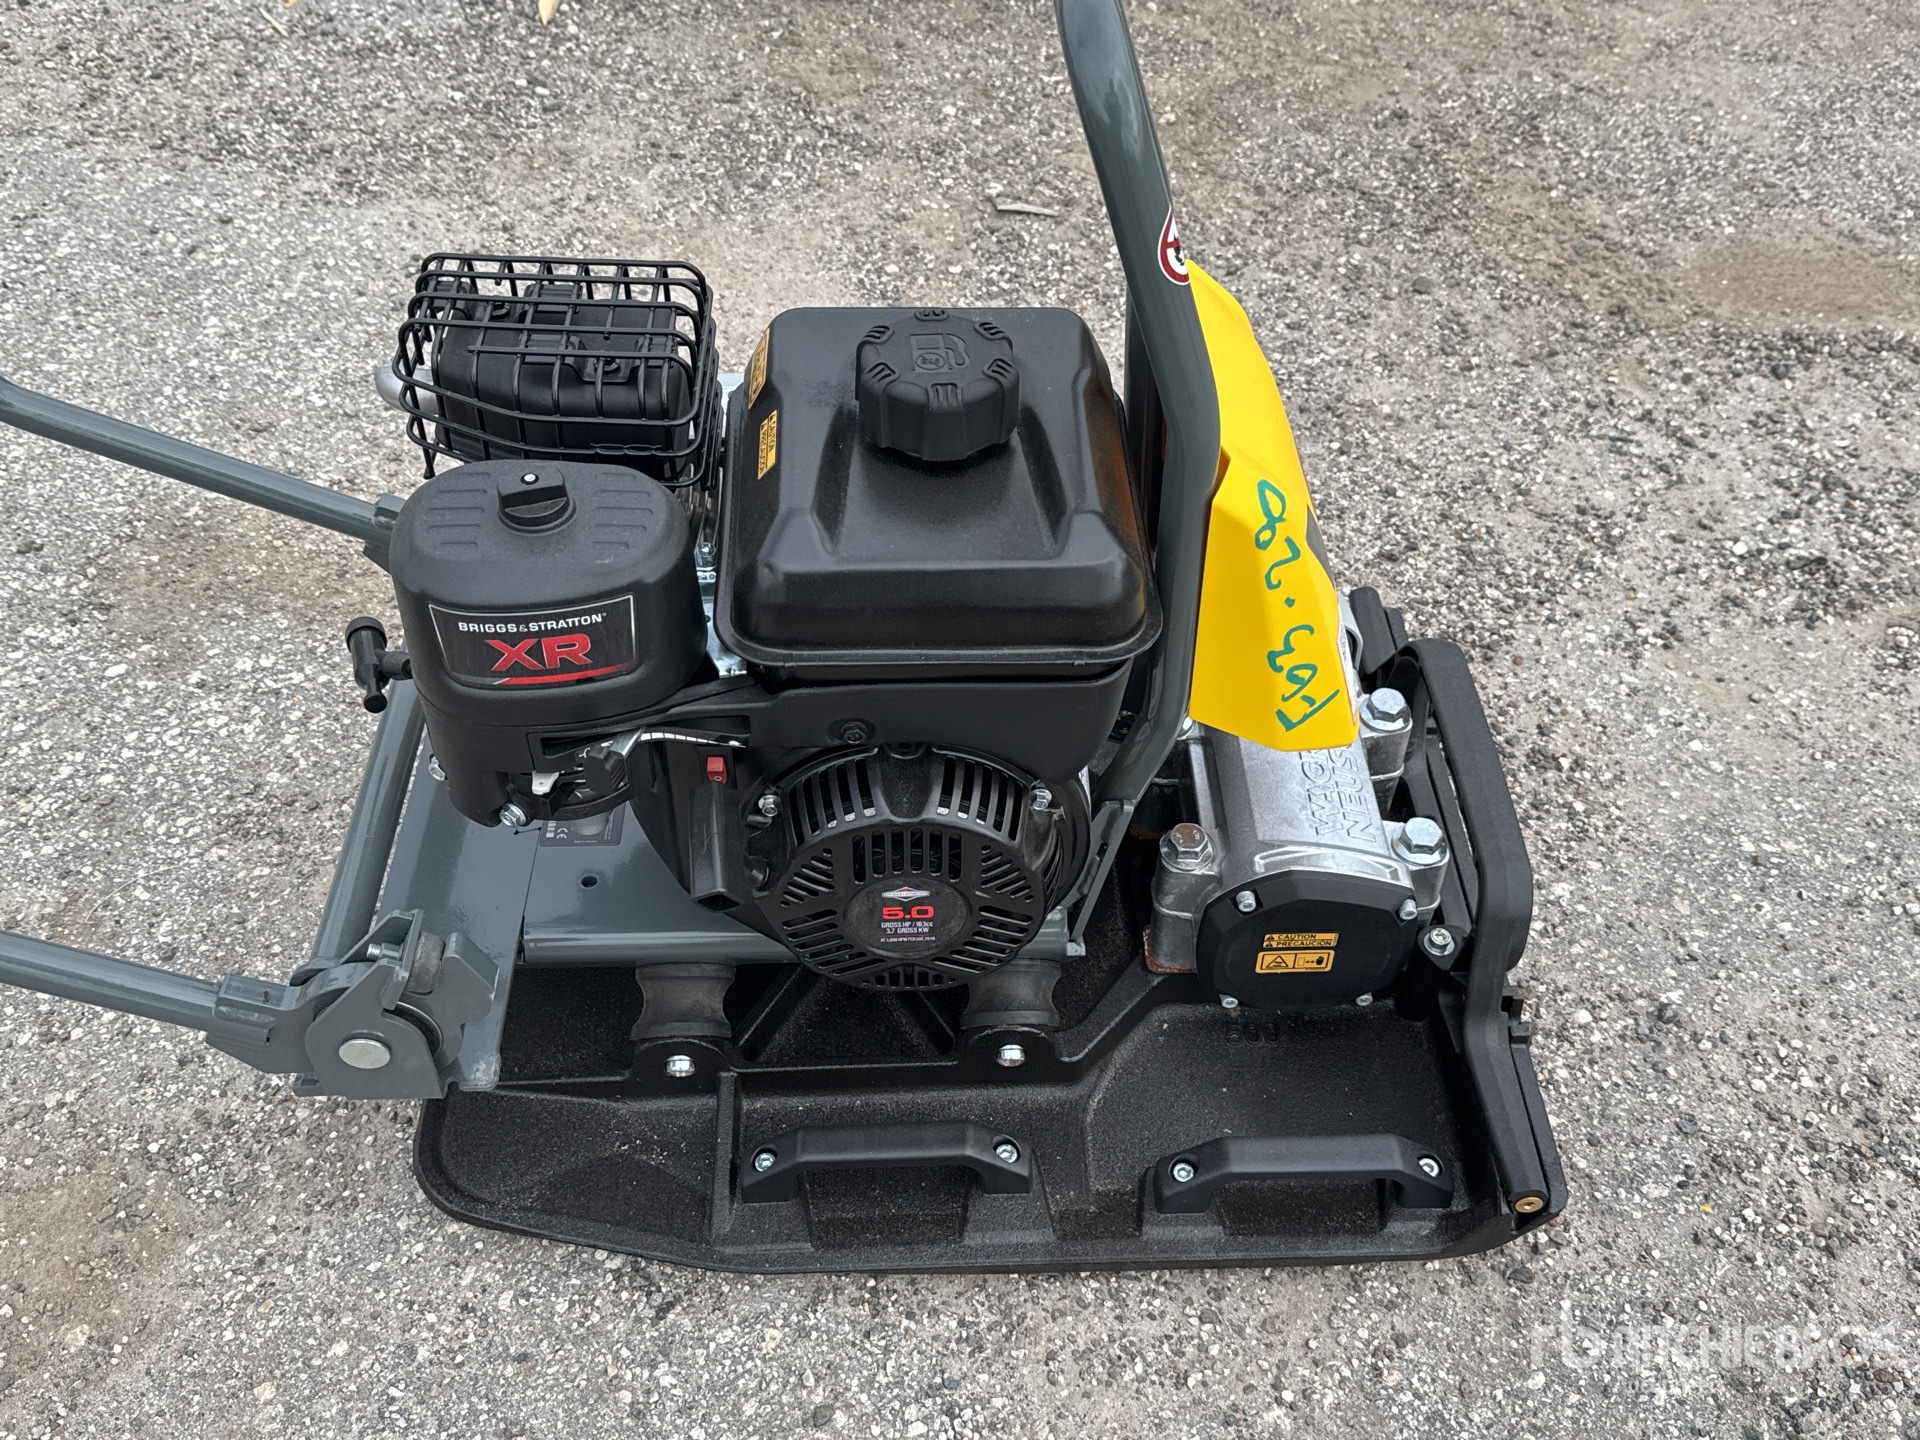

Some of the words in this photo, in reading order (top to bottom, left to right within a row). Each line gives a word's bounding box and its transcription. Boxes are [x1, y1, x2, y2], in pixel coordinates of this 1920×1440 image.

[458, 613, 603, 633] BRIGGS&STRATTON
[485, 633, 593, 671] XR
[1298, 749, 1344, 836] WACK
[1328, 744, 1377, 843] NEUS
[882, 905, 934, 920] 5.0
